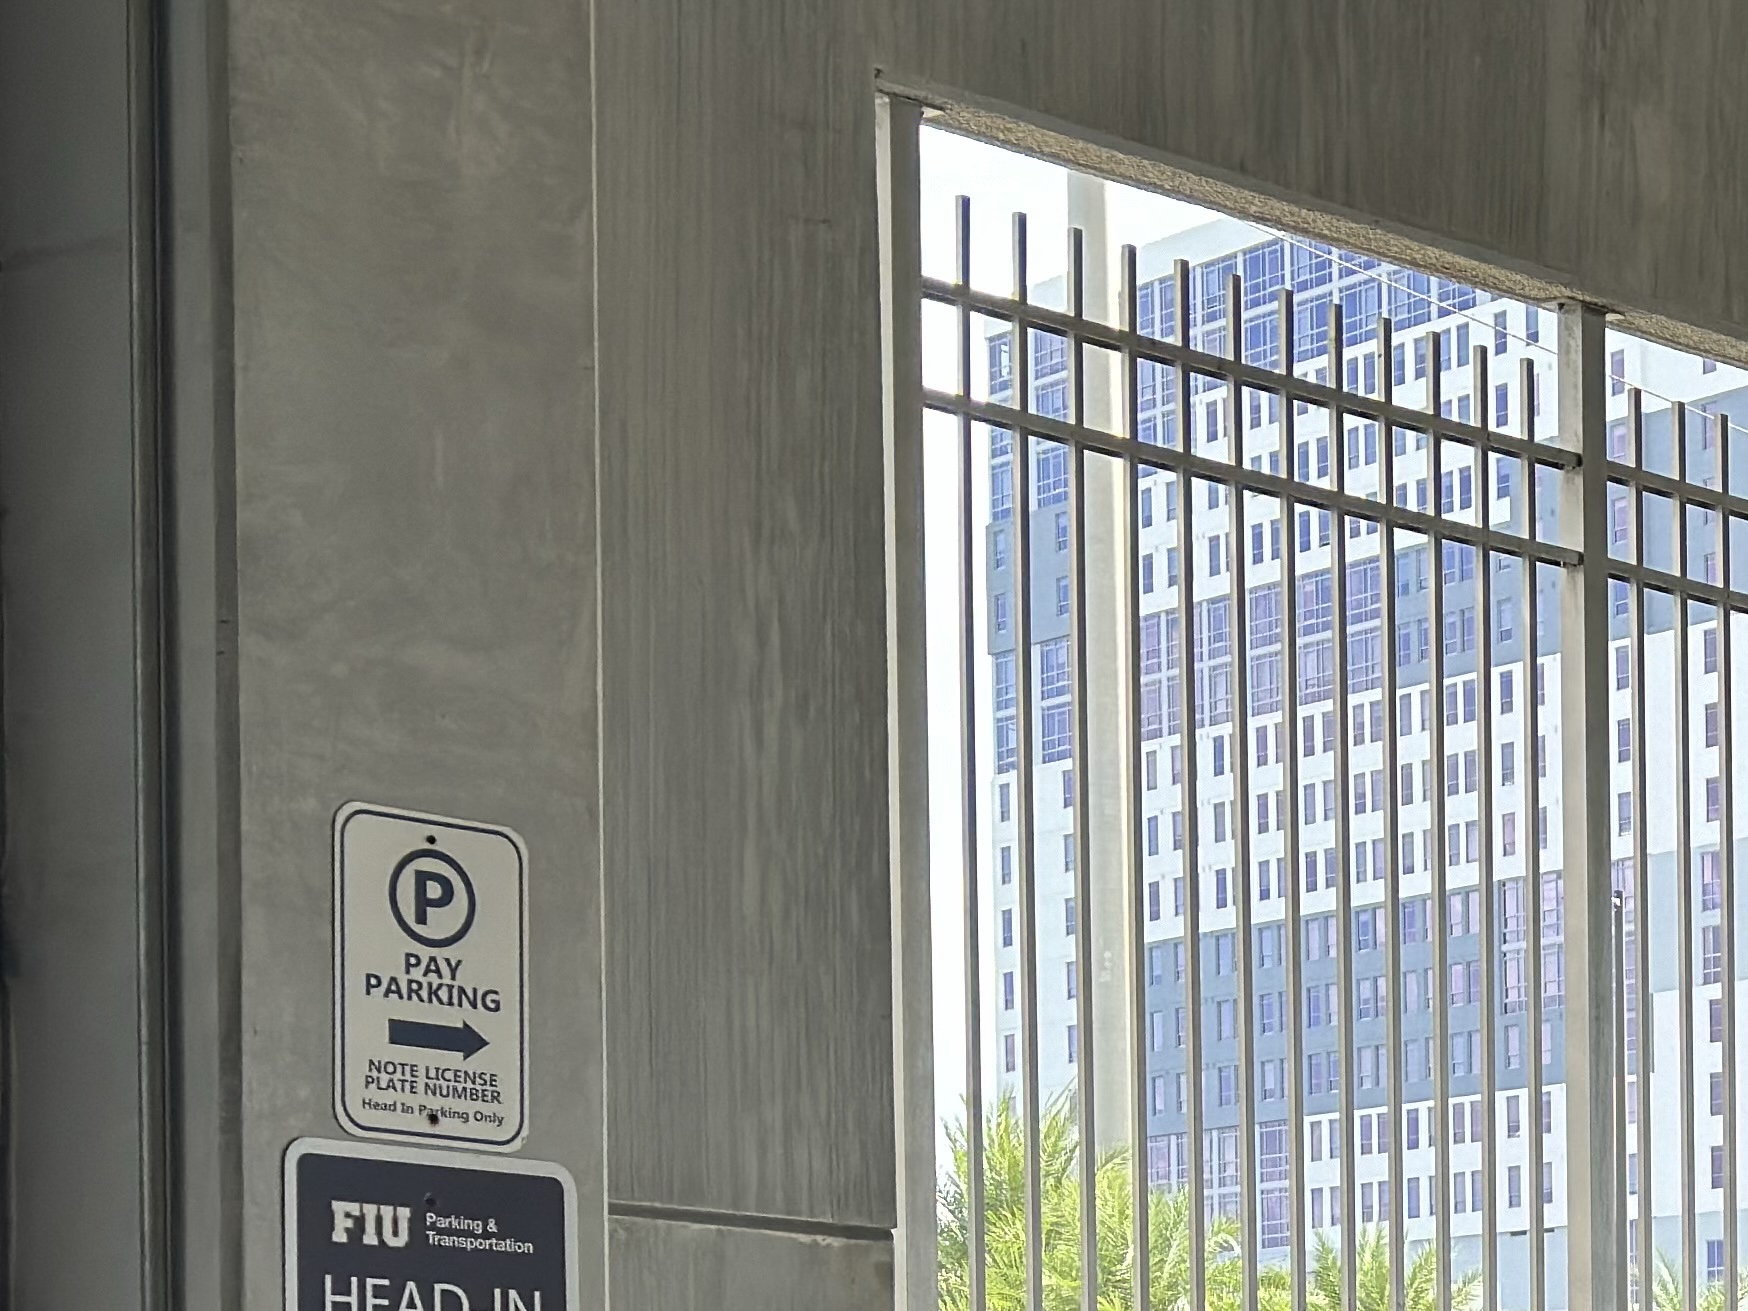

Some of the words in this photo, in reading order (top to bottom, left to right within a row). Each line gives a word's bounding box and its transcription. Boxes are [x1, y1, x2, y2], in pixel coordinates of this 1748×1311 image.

[414, 869, 454, 926] P
[404, 952, 463, 981] PAY
[365, 973, 501, 1013] PARKING
[368, 1059, 419, 1078] NOTE
[425, 1065, 498, 1087] LICENSE
[365, 1075, 418, 1094] PLATE
[424, 1082, 503, 1104] NUMBER
[362, 1098, 396, 1112] Head
[400, 1102, 414, 1114] In
[418, 1104, 470, 1123] Parking
[473, 1110, 504, 1127] Only
[331, 1200, 411, 1247] FIU
[425, 1212, 483, 1234] Parking
[486, 1218, 498, 1233] &
[425, 1231, 534, 1254] Transportation
